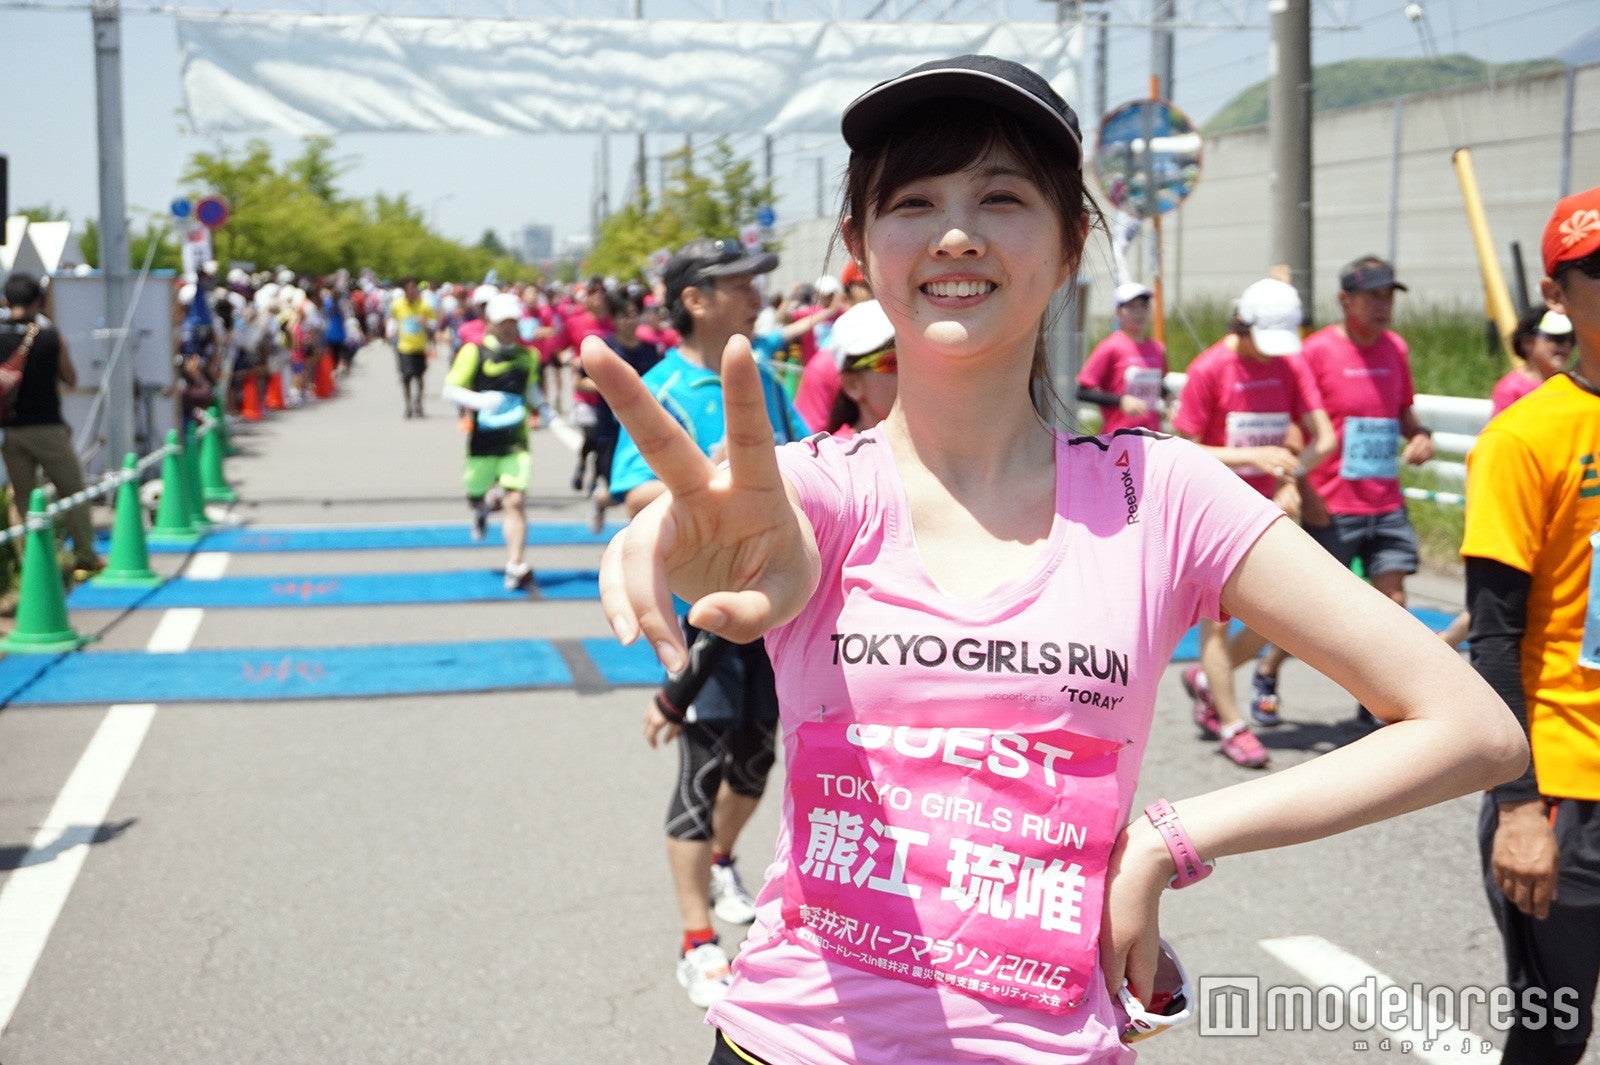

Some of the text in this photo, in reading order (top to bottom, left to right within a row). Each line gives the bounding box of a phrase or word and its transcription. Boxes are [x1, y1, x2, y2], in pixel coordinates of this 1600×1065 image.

[1121, 467, 1141, 526] Reebok
[830, 633, 1129, 687] TOKYO GIRLS RUN
[816, 773, 1088, 850] TOKYO GIRLS RUN
[799, 806, 1087, 935] 熊江 琉唯
[799, 904, 1071, 991] 軽井沢ハーフマラソン2016
